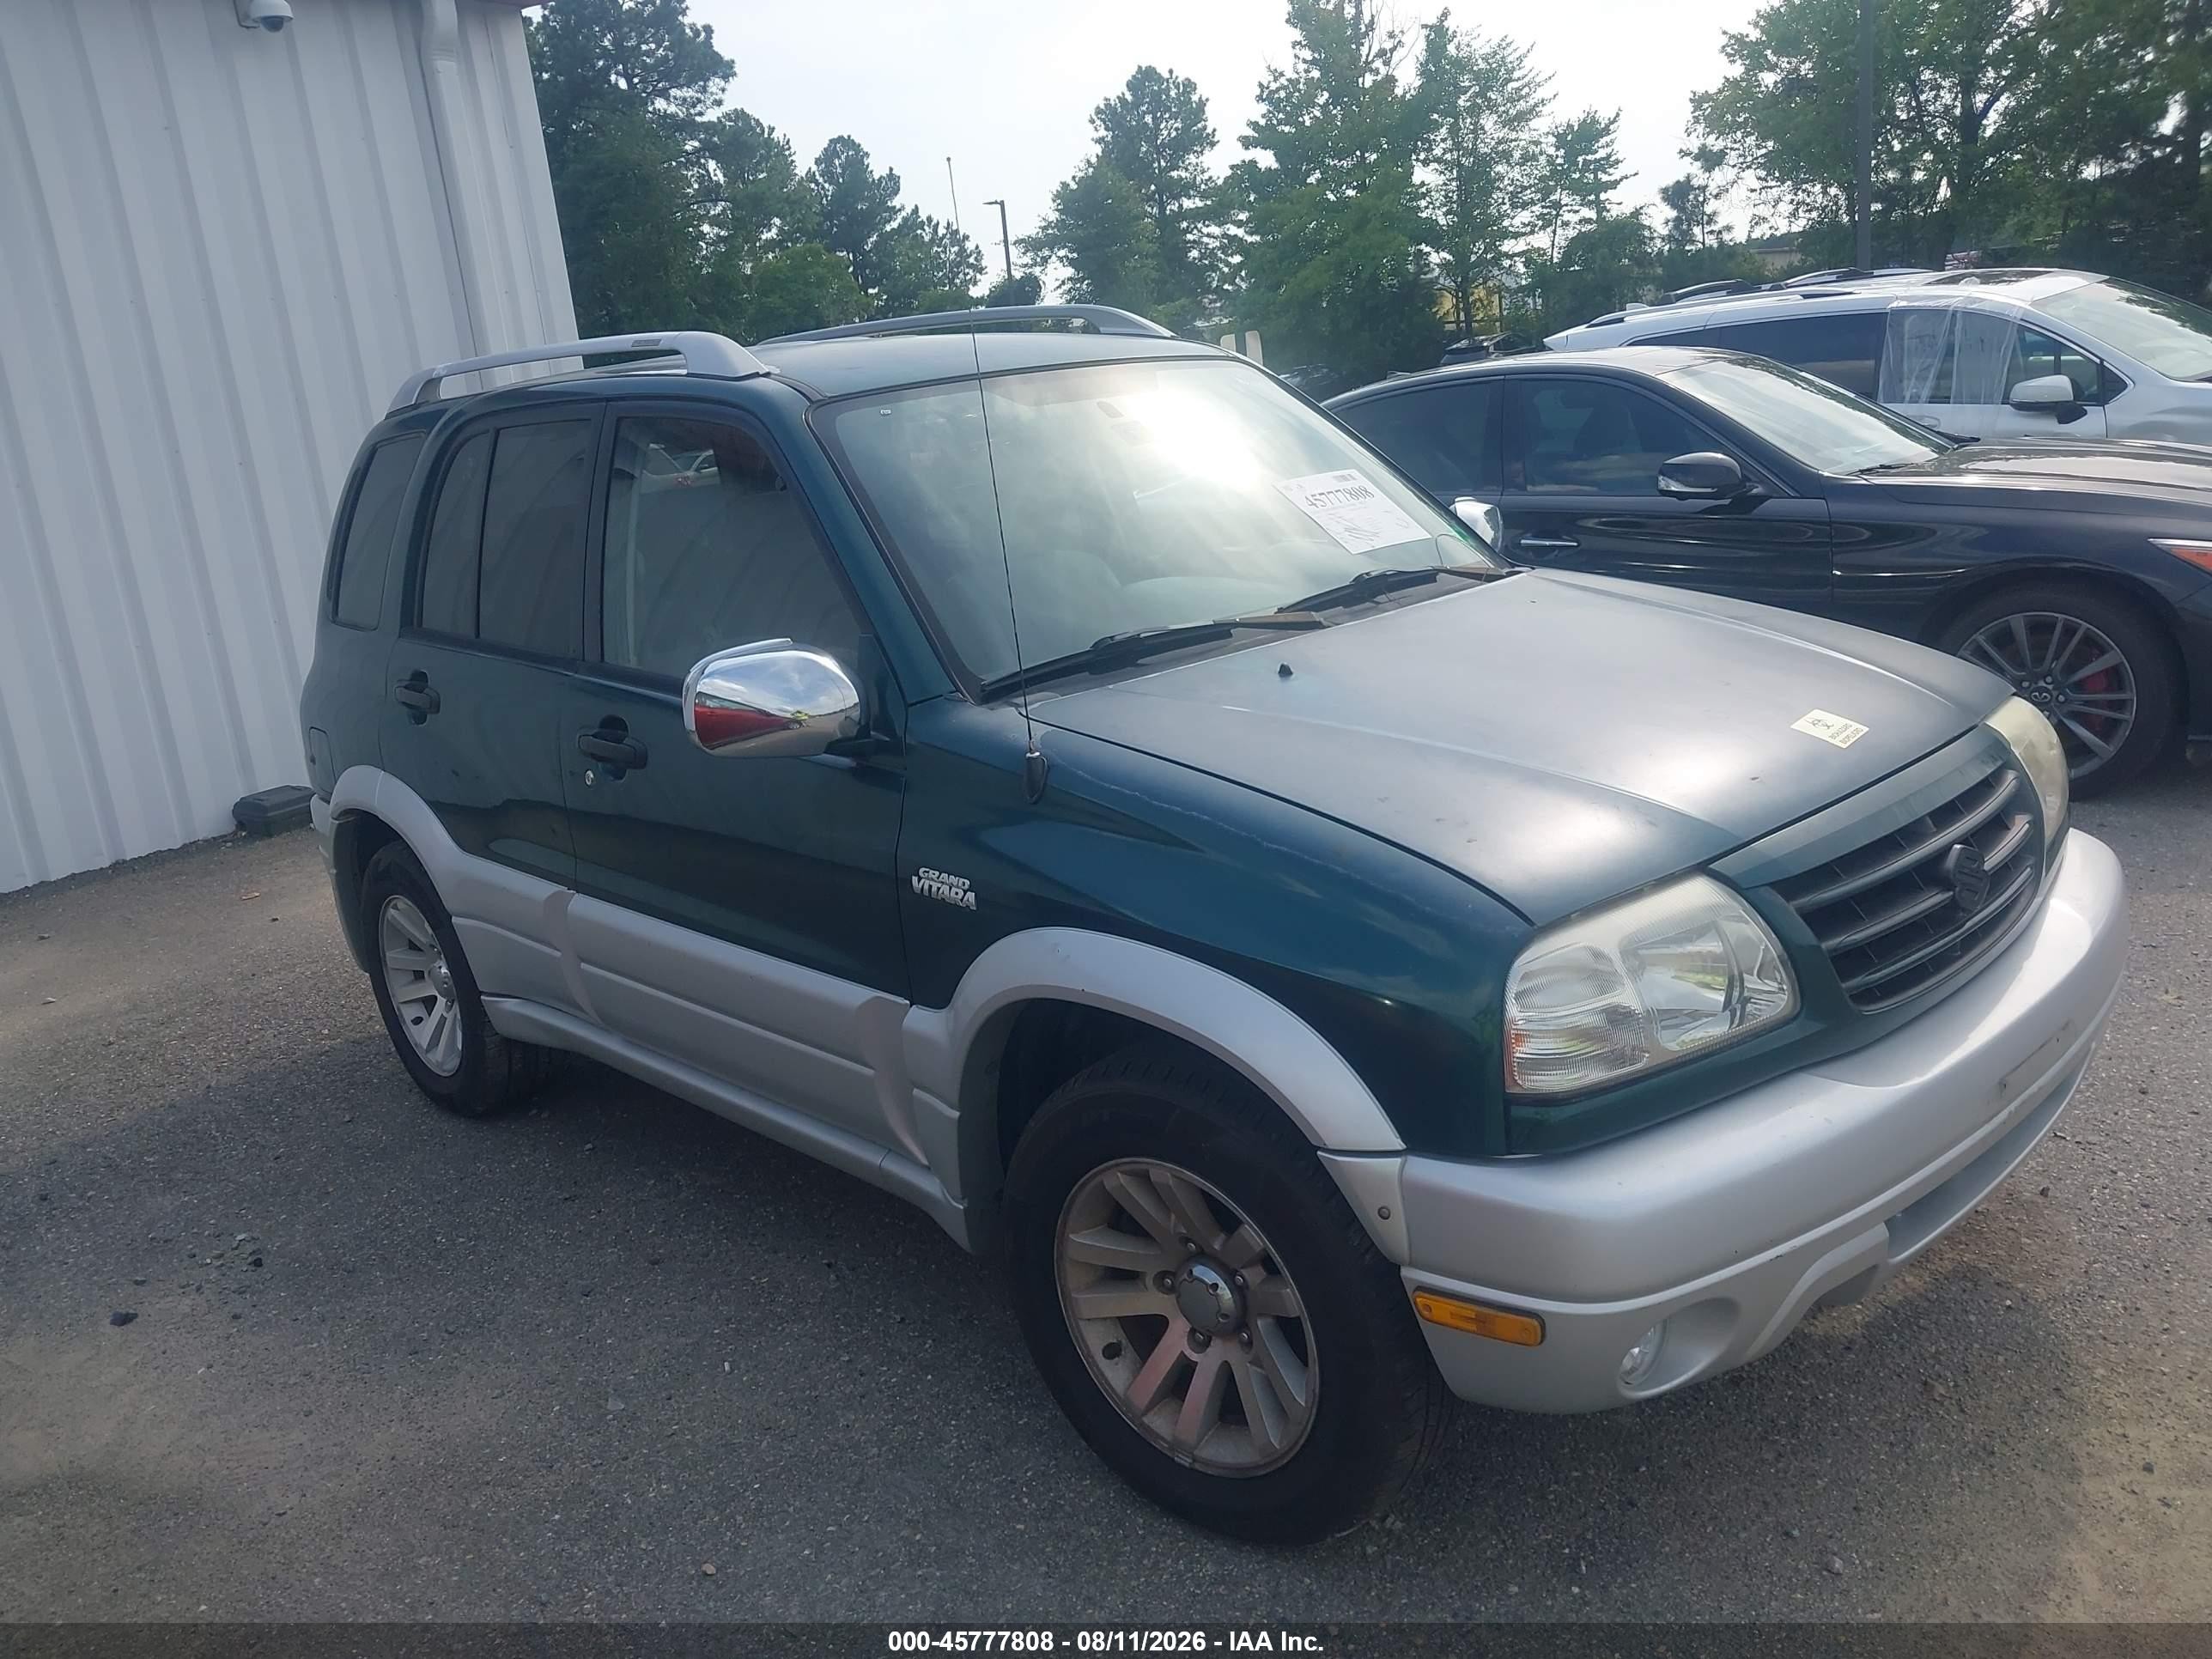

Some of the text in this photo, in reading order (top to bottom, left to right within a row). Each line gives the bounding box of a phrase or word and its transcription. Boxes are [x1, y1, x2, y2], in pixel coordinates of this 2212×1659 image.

[1304, 484, 1374, 509] 45777808
[918, 867, 970, 890] GRAND
[911, 875, 976, 910] VITARA
